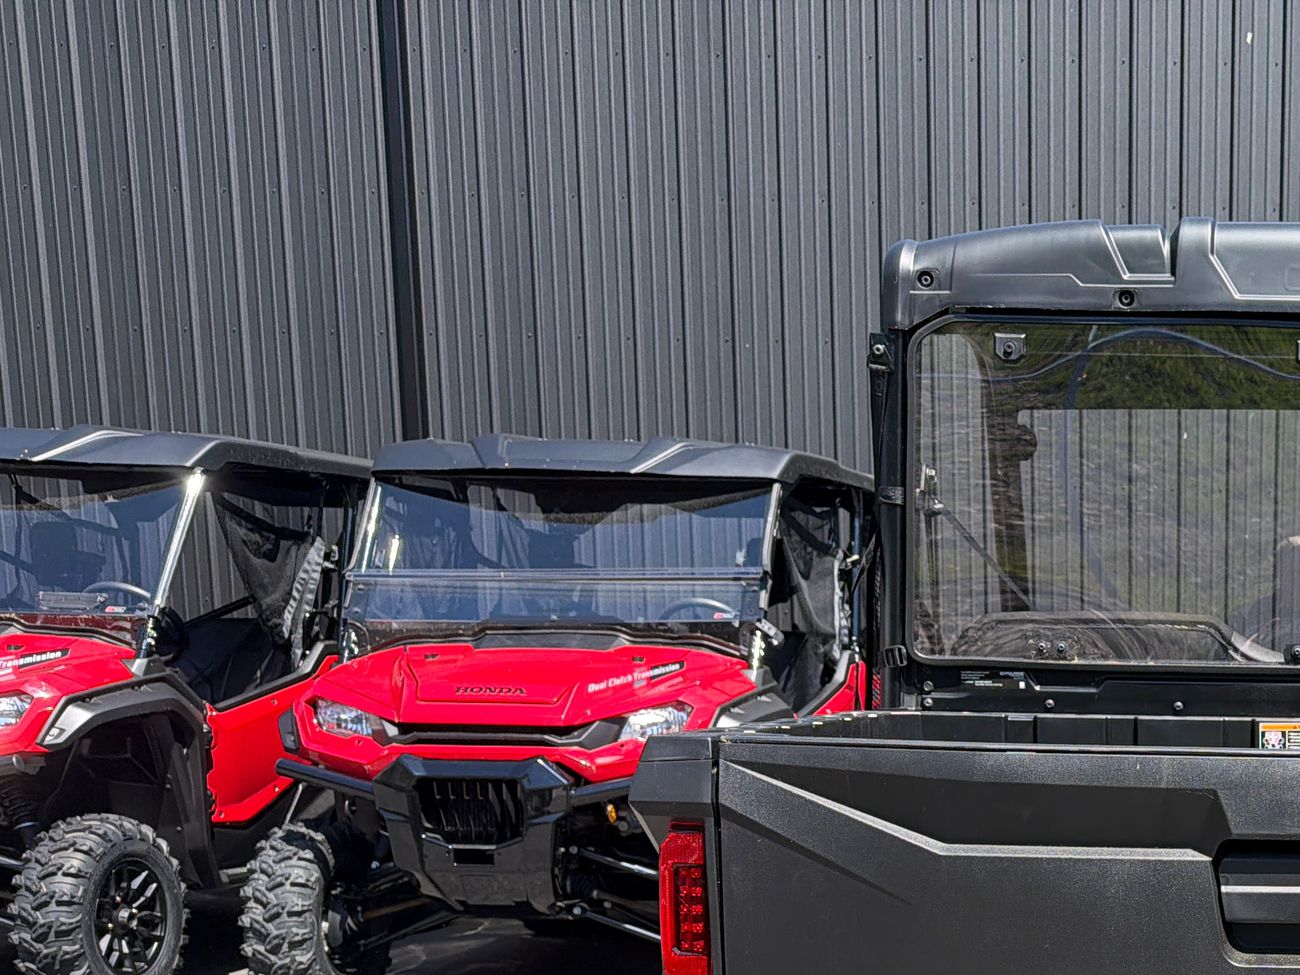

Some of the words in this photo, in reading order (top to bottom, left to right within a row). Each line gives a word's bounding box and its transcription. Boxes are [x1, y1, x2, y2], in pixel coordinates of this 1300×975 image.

[588, 681, 607, 693] Dual
[608, 674, 633, 687] Clutch
[633, 662, 680, 681] Transmission
[455, 685, 526, 695] HONDA
